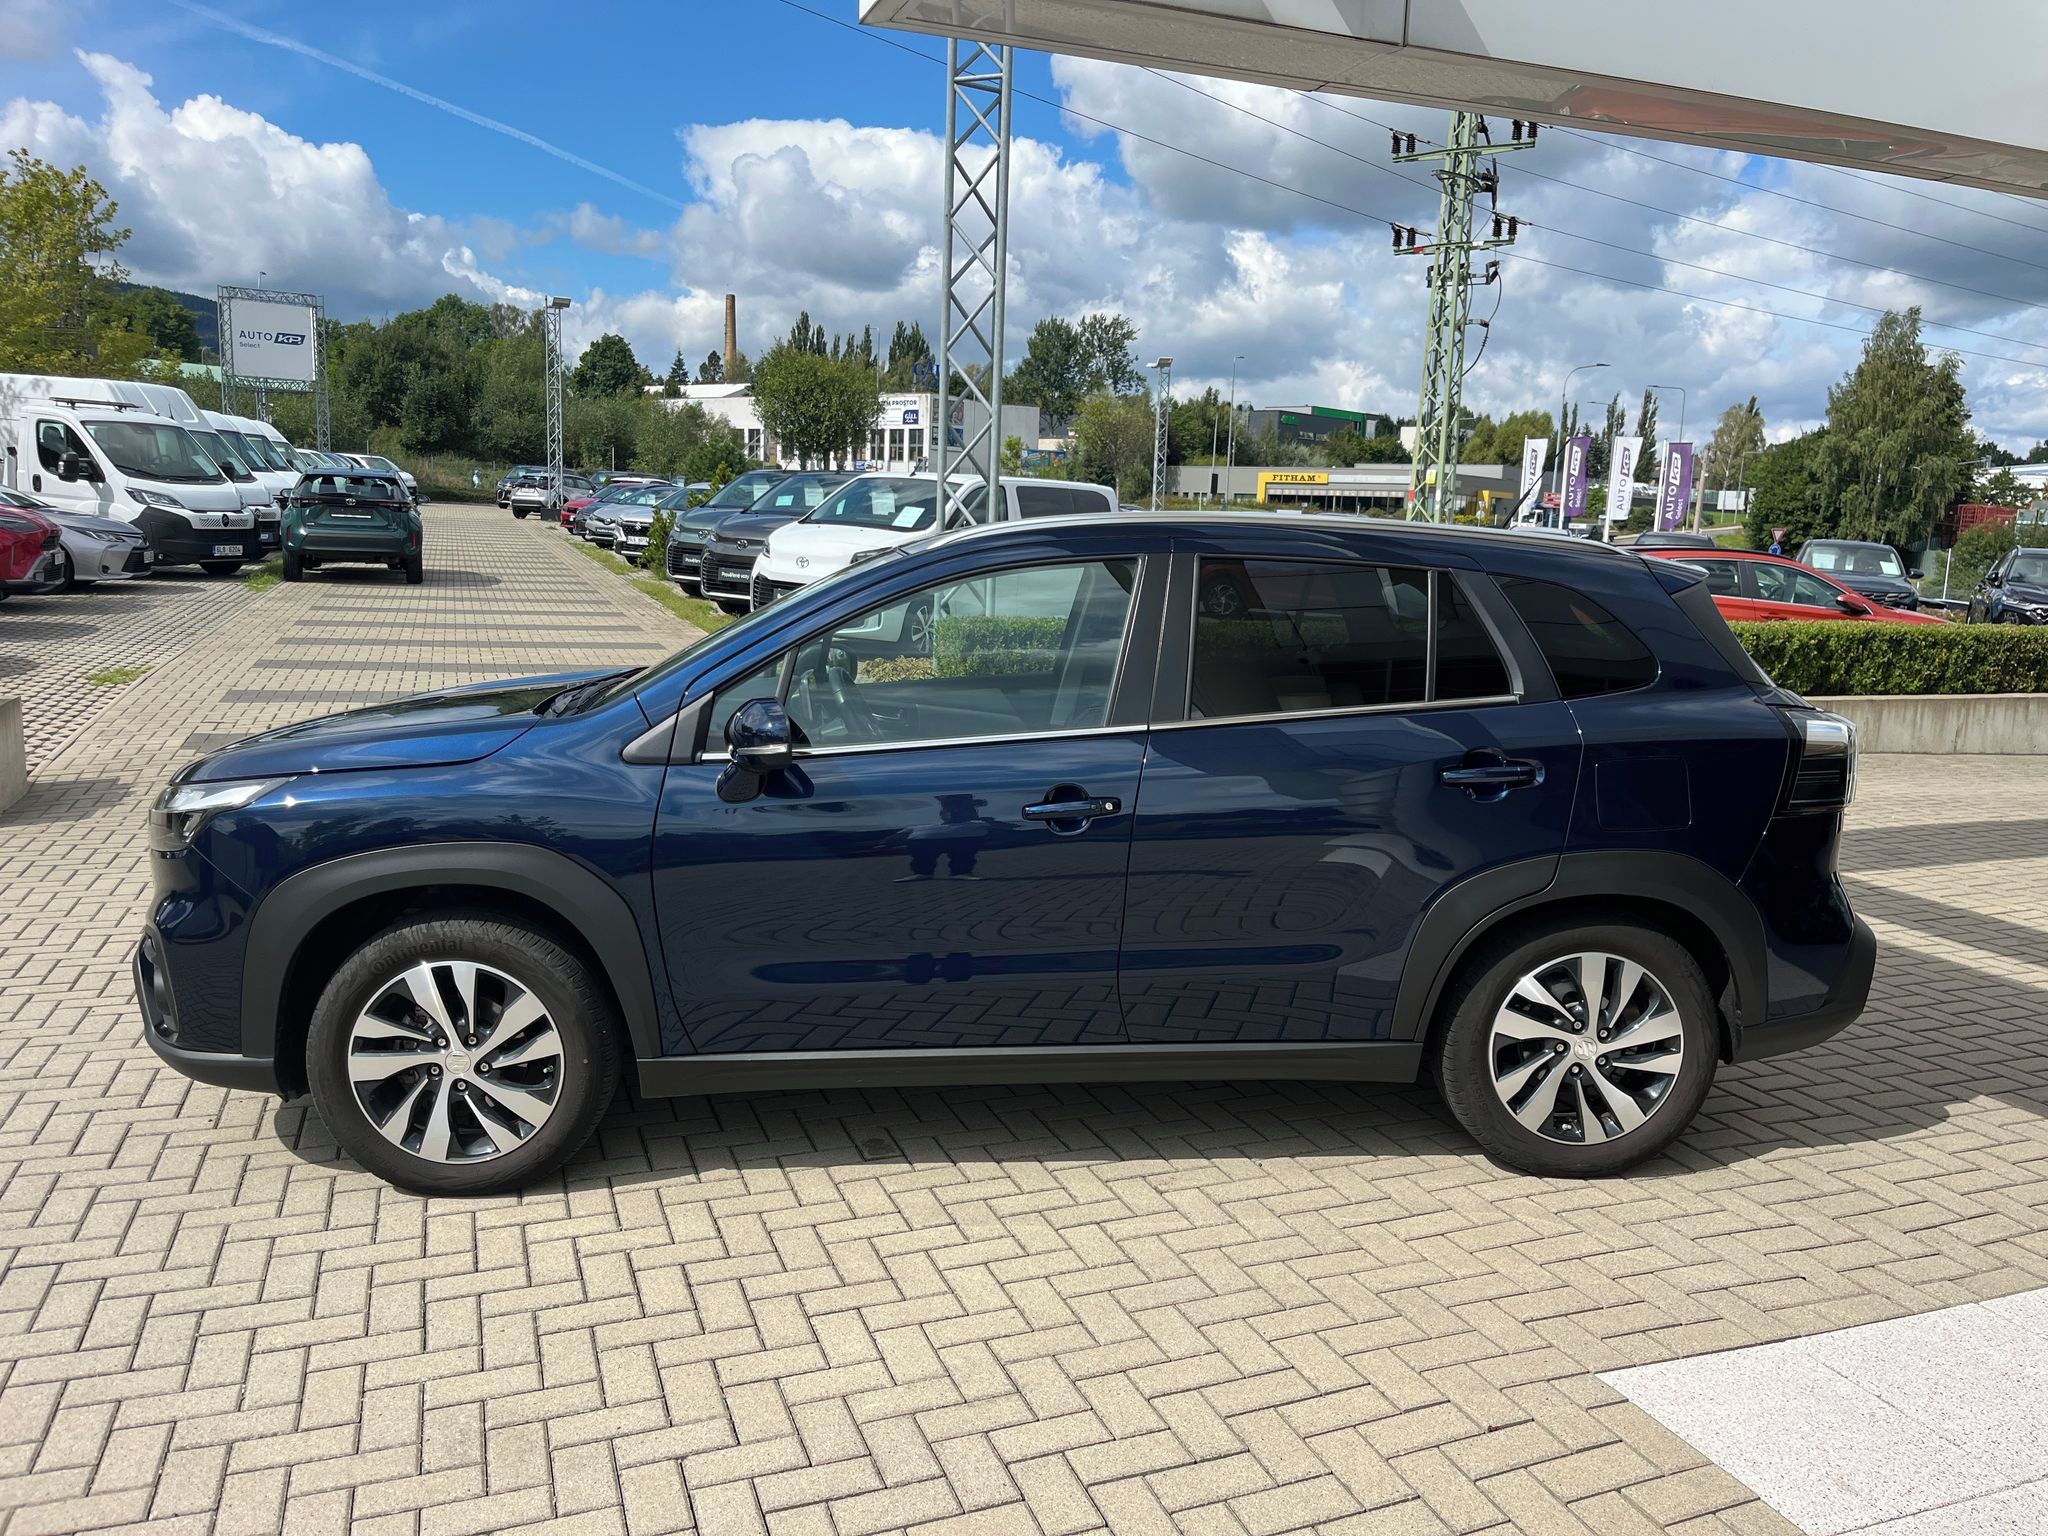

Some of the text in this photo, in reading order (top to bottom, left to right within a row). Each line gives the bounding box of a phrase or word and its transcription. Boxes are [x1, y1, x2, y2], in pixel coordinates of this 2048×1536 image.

[239, 330, 273, 341] AUTO
[1616, 478, 1627, 511] AUTO
[1665, 485, 1677, 520] AUTO
[1675, 498, 1684, 520] Select
